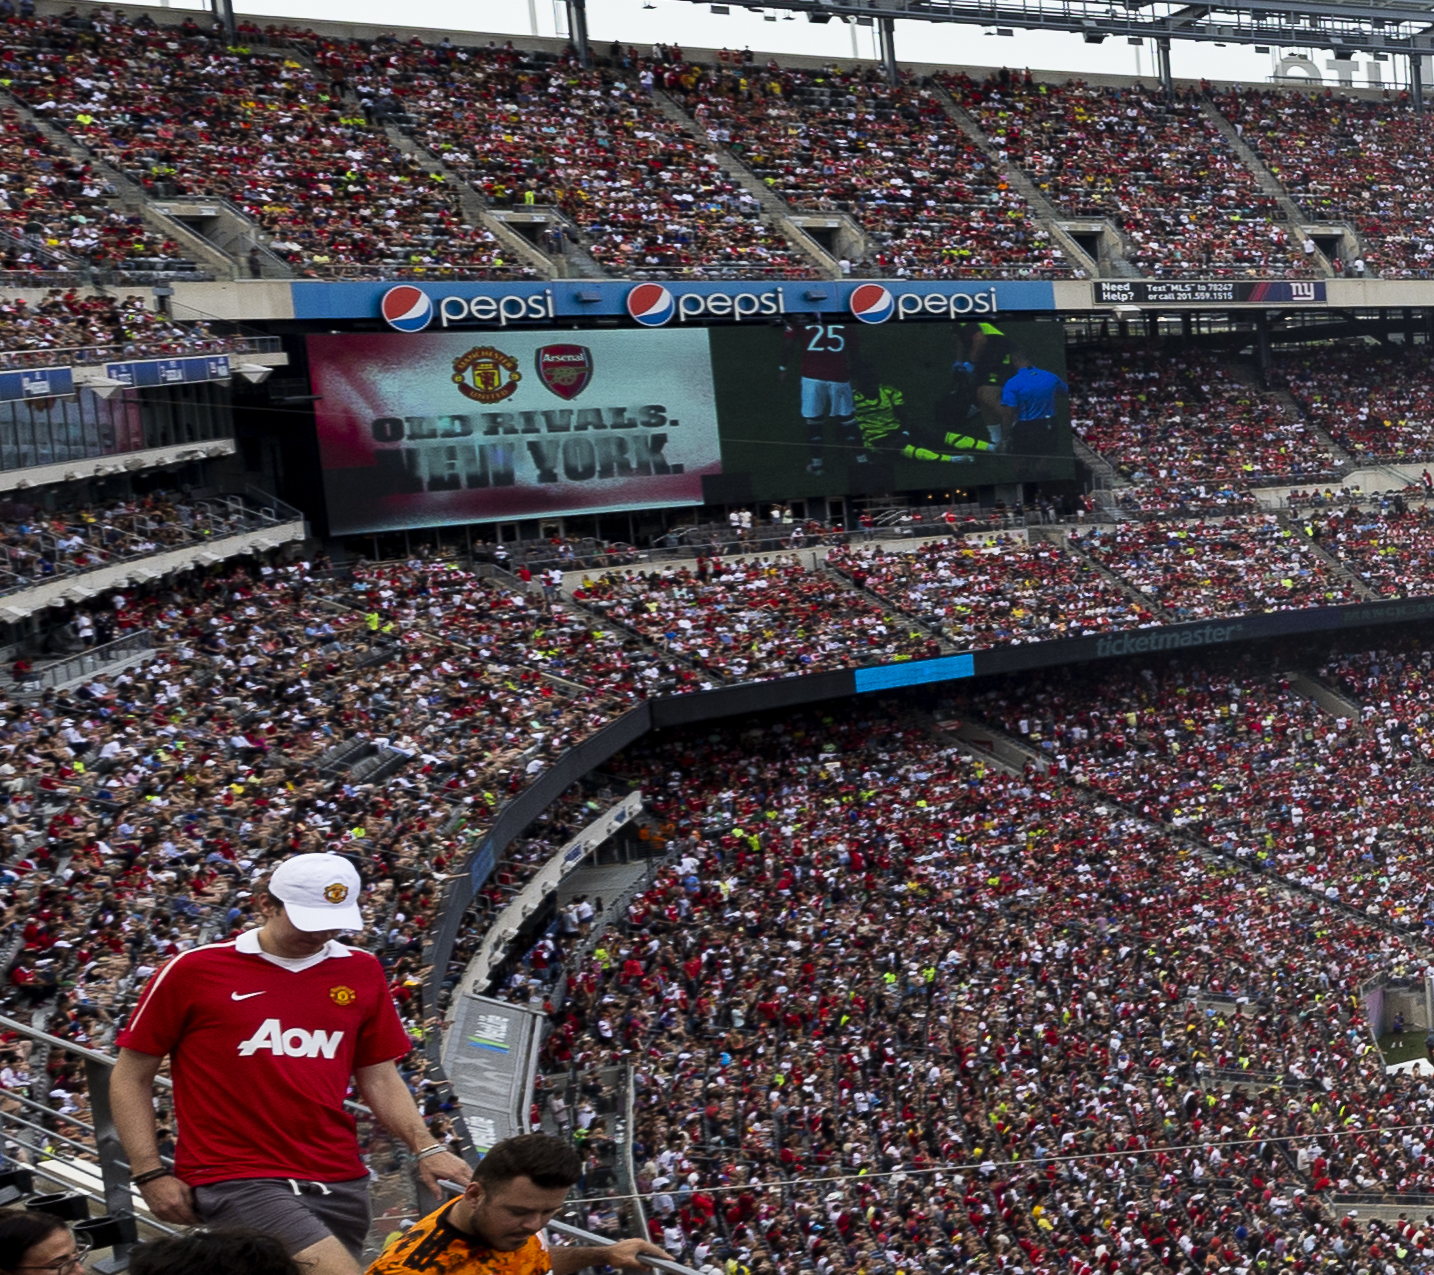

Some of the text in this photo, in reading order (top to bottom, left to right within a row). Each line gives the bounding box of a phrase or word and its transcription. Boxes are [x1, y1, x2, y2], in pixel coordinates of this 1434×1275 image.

[899, 287, 998, 319] pepsi
[1102, 283, 1130, 291] Need
[1102, 292, 1134, 302] Help?
[440, 289, 555, 326] pepsi
[680, 287, 785, 321] pepsi
[805, 325, 845, 352] 25
[543, 352, 584, 363] Arsenal
[372, 404, 680, 442] OLD RIVALS.
[526, 433, 685, 485] YORK.
[237, 1018, 345, 1060] AON
